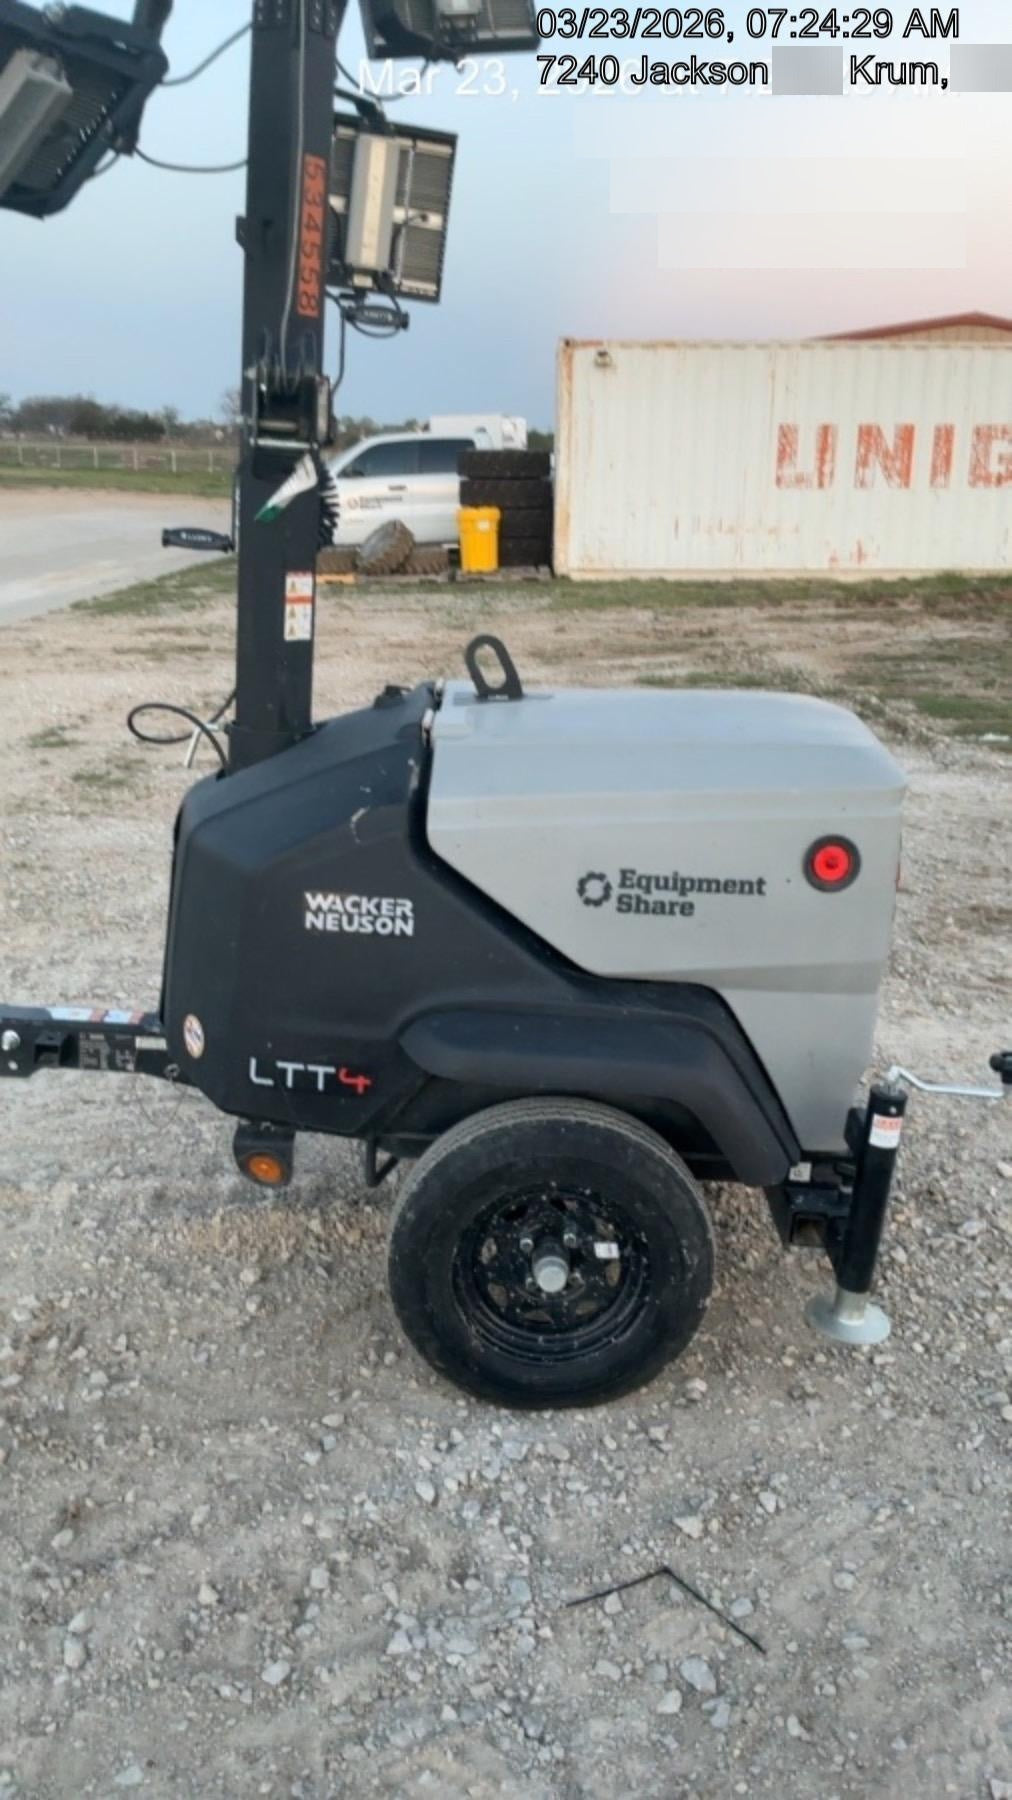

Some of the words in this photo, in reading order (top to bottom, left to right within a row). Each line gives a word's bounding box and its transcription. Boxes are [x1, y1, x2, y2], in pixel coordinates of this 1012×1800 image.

[618, 868, 766, 896] Equipment
[304, 891, 413, 918] WACKER
[616, 893, 695, 917] Share
[305, 911, 414, 936] NEUSON
[250, 1057, 371, 1094] LTT4
